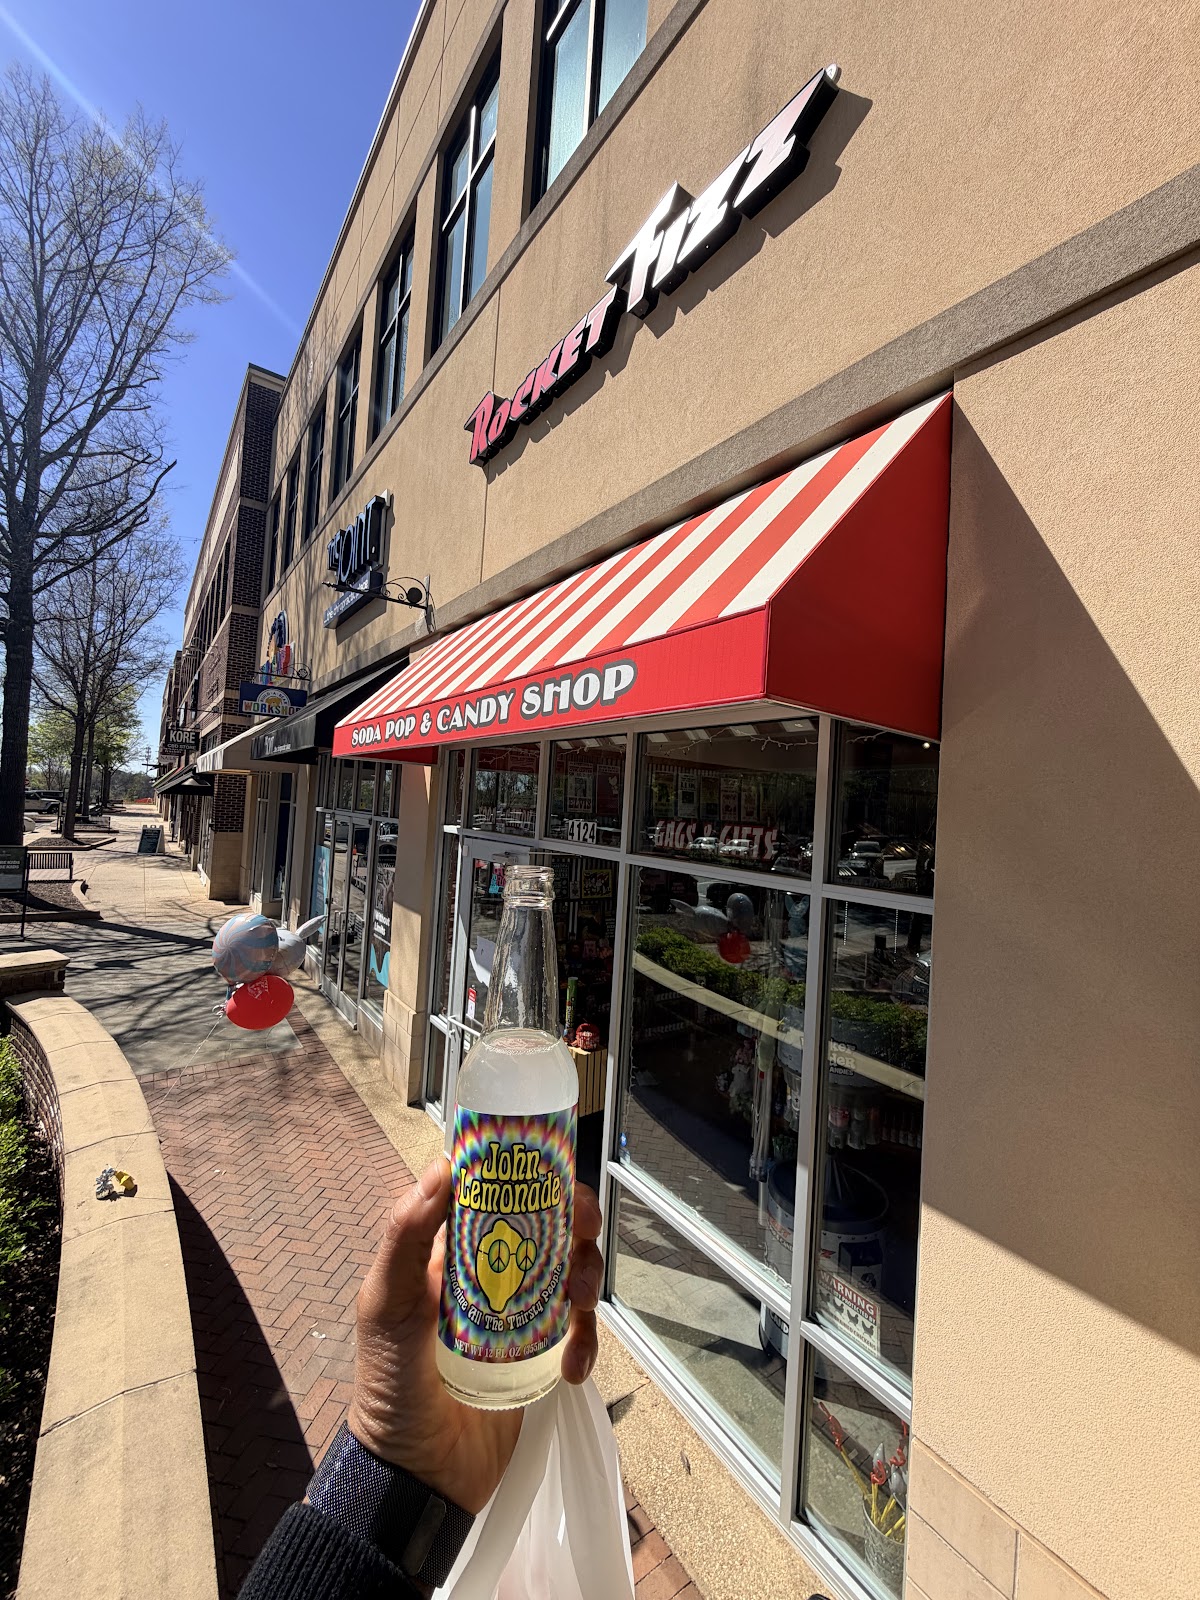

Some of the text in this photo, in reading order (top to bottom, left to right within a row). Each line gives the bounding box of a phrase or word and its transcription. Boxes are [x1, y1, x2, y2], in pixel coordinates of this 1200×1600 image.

[351, 662, 635, 747] SODA POP & CANDY SHOP
[170, 730, 196, 744] KORE
[568, 820, 596, 843] 4124
[481, 1142, 541, 1181] John
[458, 1167, 561, 1214] Lemonade
[449, 1261, 563, 1332] Imagine All The Thirsty People
[820, 1270, 875, 1316] WARNING
[454, 1337, 470, 1353] NET
[470, 1344, 484, 1358] WT
[484, 1347, 494, 1358] 12
[495, 1347, 507, 1358] FL
[508, 1345, 521, 1358] OZ
